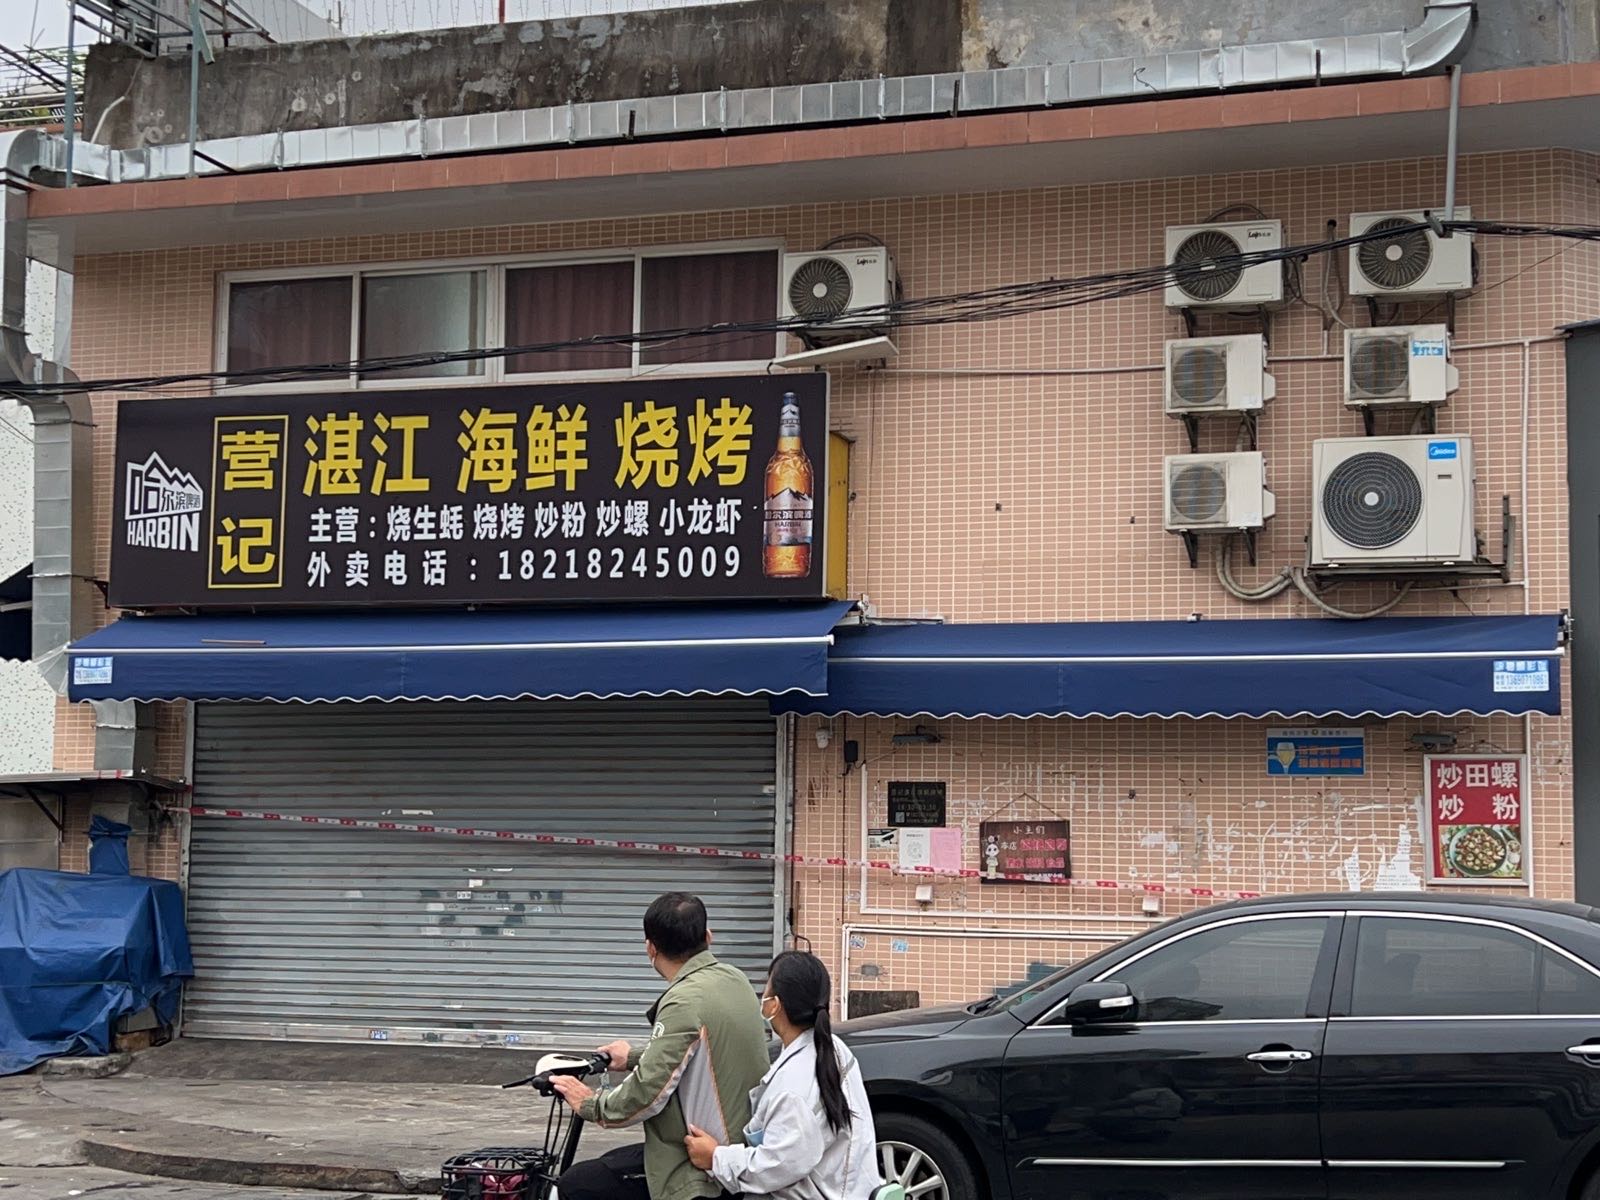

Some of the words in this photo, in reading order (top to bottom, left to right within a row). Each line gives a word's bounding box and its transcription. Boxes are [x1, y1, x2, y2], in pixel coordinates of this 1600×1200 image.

[303, 412, 430, 497] 湛江
[457, 404, 588, 494] 海鲜
[614, 398, 753, 489] 烧烤
[216, 431, 281, 574] 营记
[473, 503, 525, 540] 烧烤
[534, 501, 587, 539] 炒粉
[596, 500, 649, 538] 炒螺
[659, 498, 742, 536] 小龙虾
[126, 513, 200, 552] HARBIN
[498, 545, 740, 580] 18218245009
[1437, 762, 1519, 789] 炒田螺
